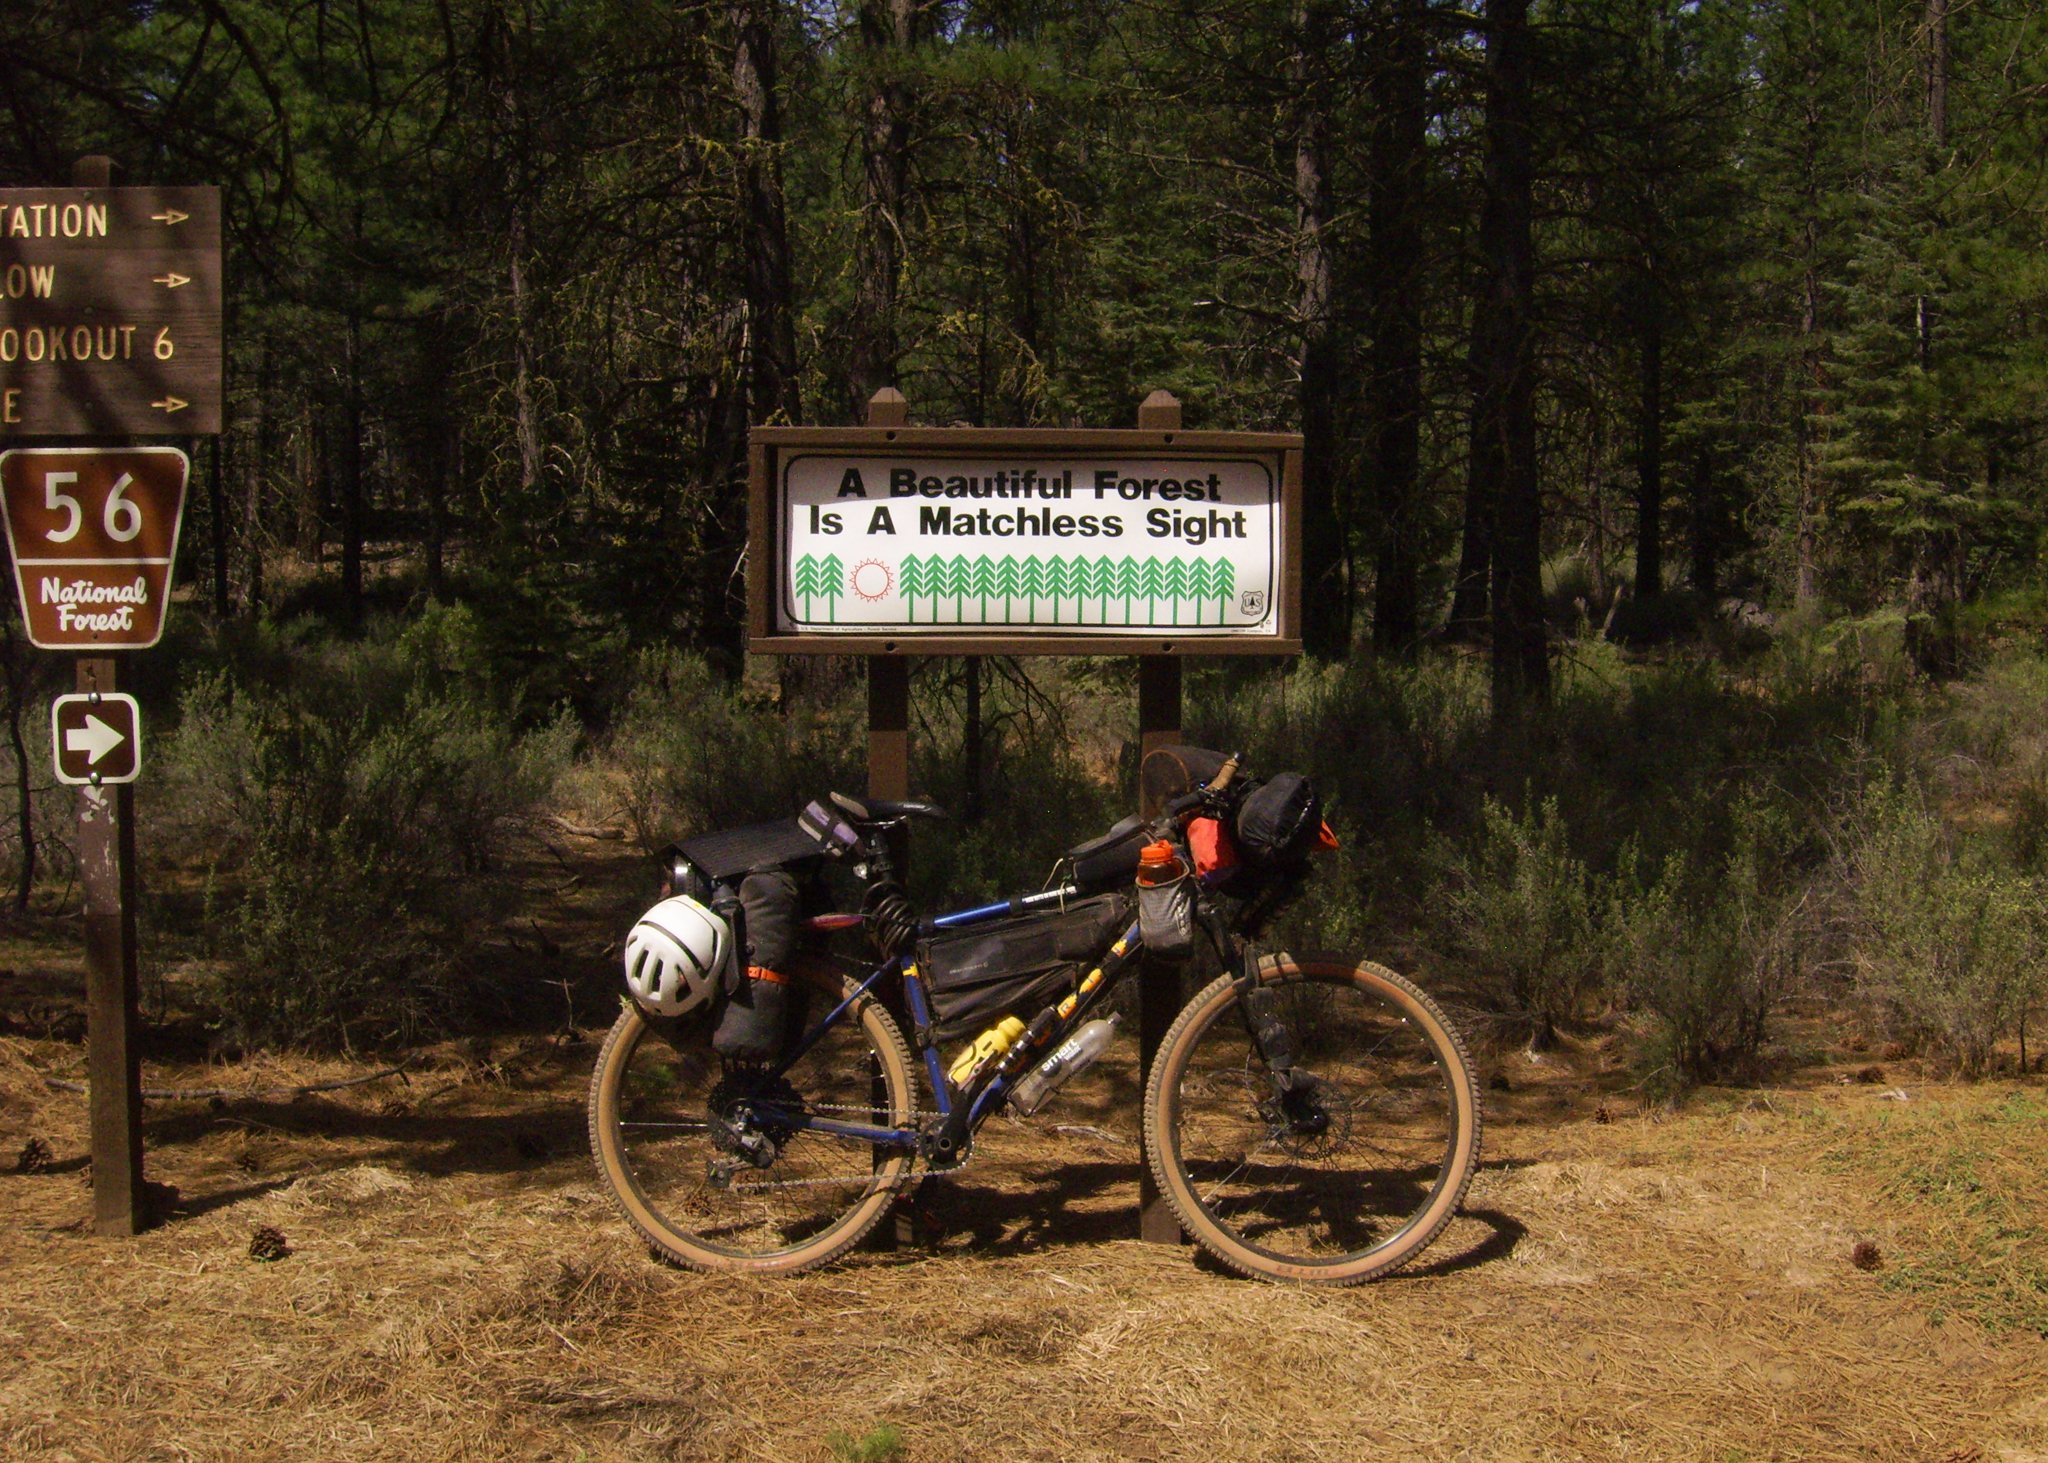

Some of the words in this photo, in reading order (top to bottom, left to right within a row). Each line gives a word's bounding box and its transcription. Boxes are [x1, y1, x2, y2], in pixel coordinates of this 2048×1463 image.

[0, 265, 54, 298] OW
[153, 326, 174, 360] 6
[837, 467, 867, 498] A
[889, 467, 1072, 499] Beautiful
[1094, 470, 1221, 502] Forest
[810, 504, 844, 535] Is
[866, 505, 897, 535] A
[919, 505, 1124, 538] Matchless
[1146, 507, 1247, 546] Sight
[41, 576, 148, 605] National
[56, 603, 134, 632] Forest
[1041, 1038, 1078, 1072] smart
